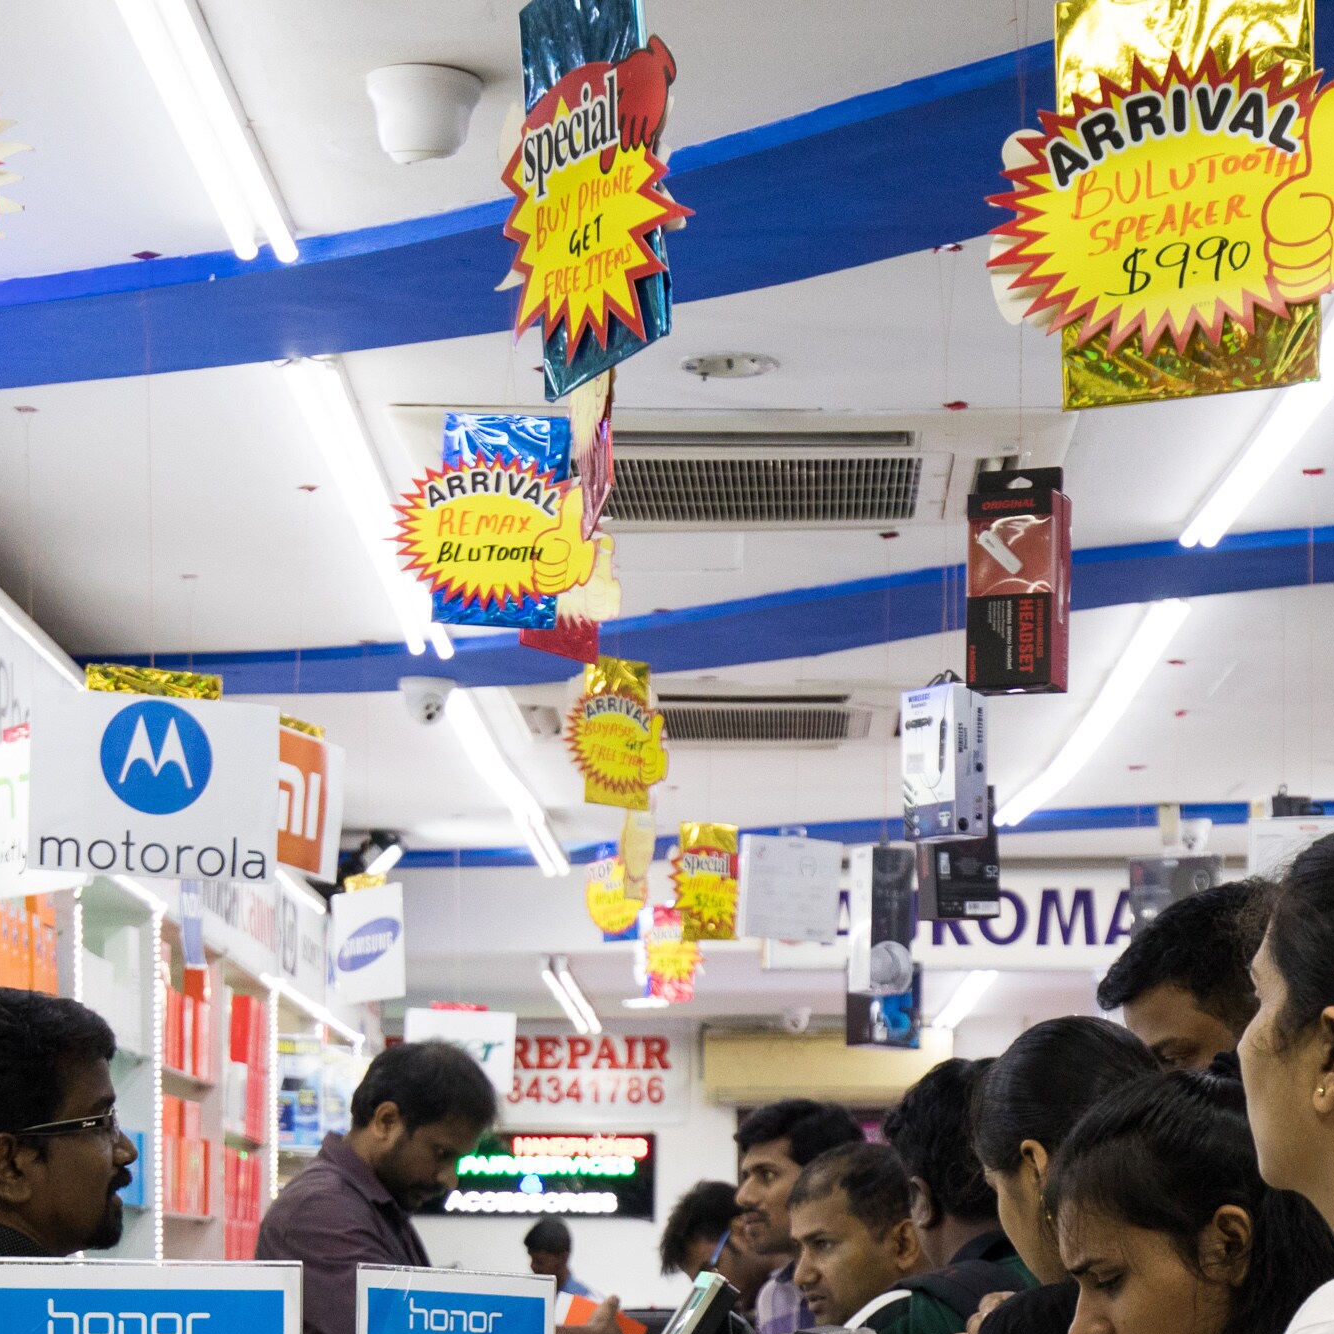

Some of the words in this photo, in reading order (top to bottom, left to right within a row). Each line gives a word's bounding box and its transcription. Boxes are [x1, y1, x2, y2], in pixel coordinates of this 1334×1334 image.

[524, 73, 618, 197] special
[1049, 88, 1300, 186] ARRIVAL
[536, 194, 571, 251] BUY
[578, 166, 633, 228] PHONE
[1089, 194, 1252, 257] SPEAKER
[569, 213, 603, 257] GET
[544, 264, 581, 298] FREE
[1105, 236, 1251, 297] $9.90
[427, 471, 562, 516] ARRIVAL
[437, 508, 532, 537] REMAX
[437, 541, 544, 564] BLUTOOTH
[1018, 598, 1034, 673] HEADSET
[585, 696, 651, 732] ARRIVAL
[40, 830, 266, 879] motorola
[683, 852, 731, 876] special
[343, 930, 393, 958] SAMSUNG
[514, 1035, 671, 1070] REPAIR
[409, 1297, 503, 1333] honor
